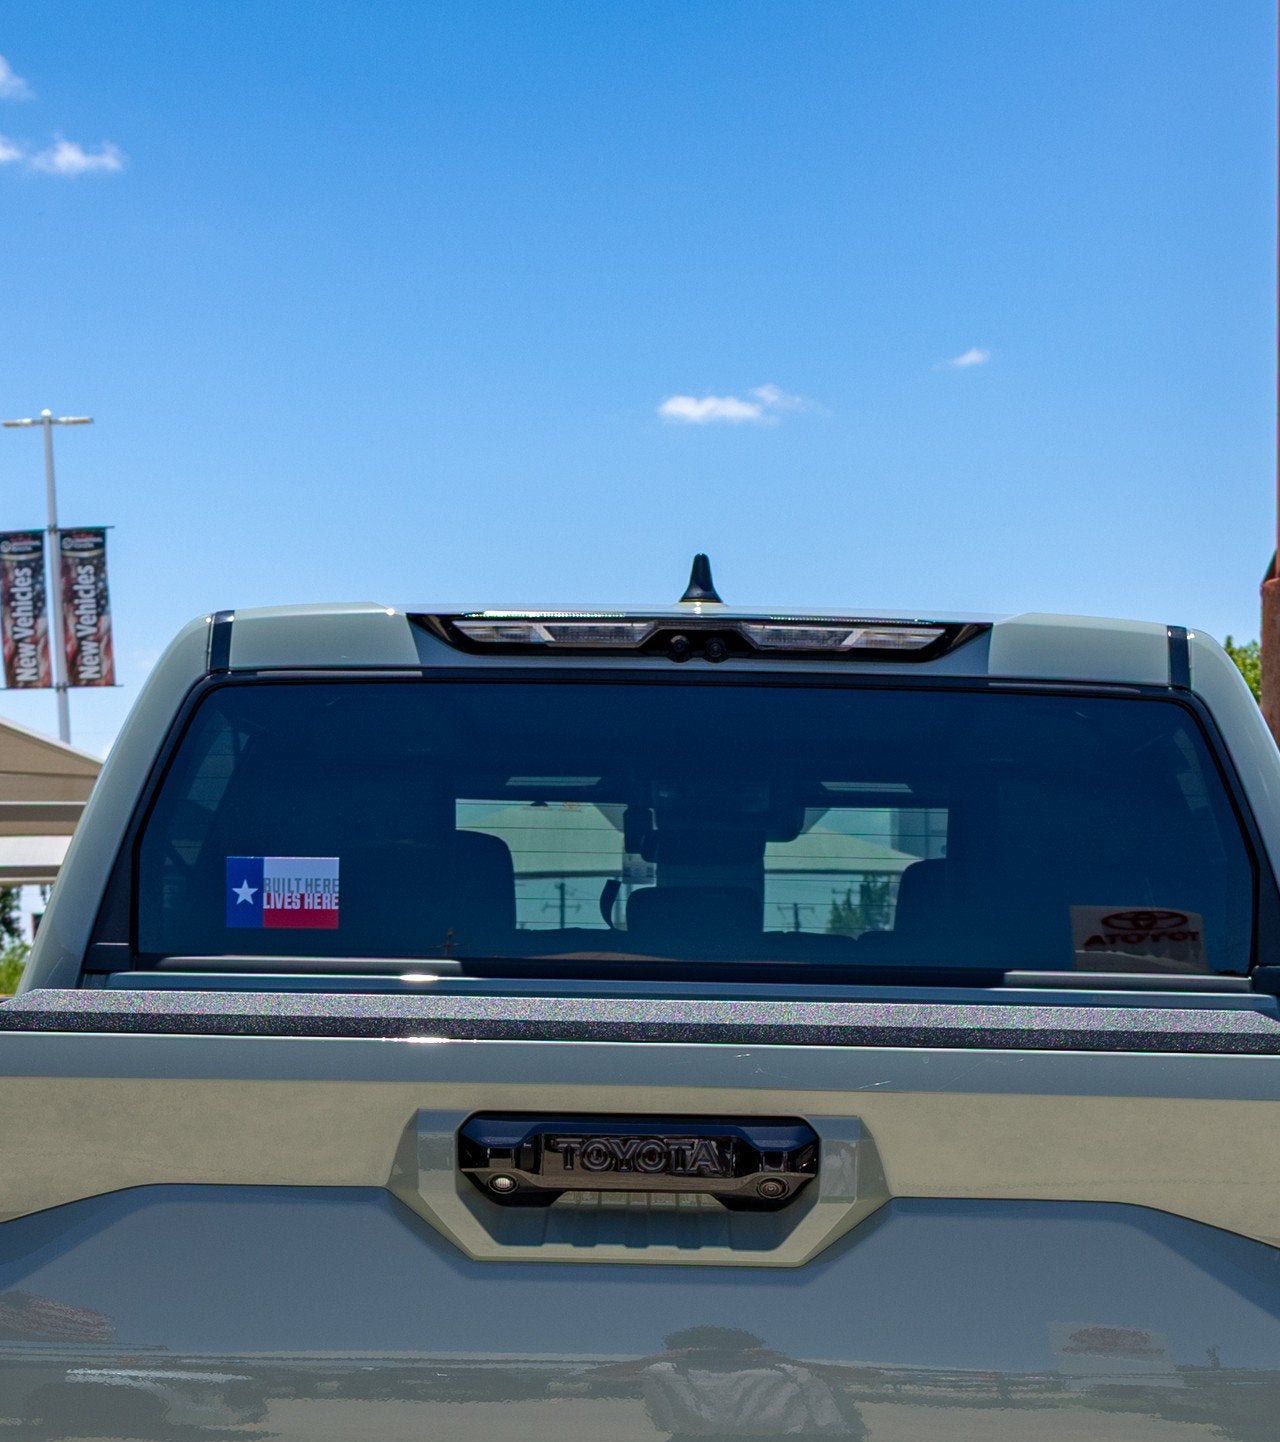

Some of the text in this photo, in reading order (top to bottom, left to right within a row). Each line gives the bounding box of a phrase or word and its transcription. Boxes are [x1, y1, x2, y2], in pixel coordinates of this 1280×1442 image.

[10, 567, 34, 641] Vehicles
[73, 564, 98, 639] Vehicles
[16, 641, 38, 682] New
[78, 639, 101, 680] New
[263, 878, 339, 893] BUILT HERE
[263, 892, 339, 909] LIVES HERE
[555, 1138, 720, 1172] TOYOTA
